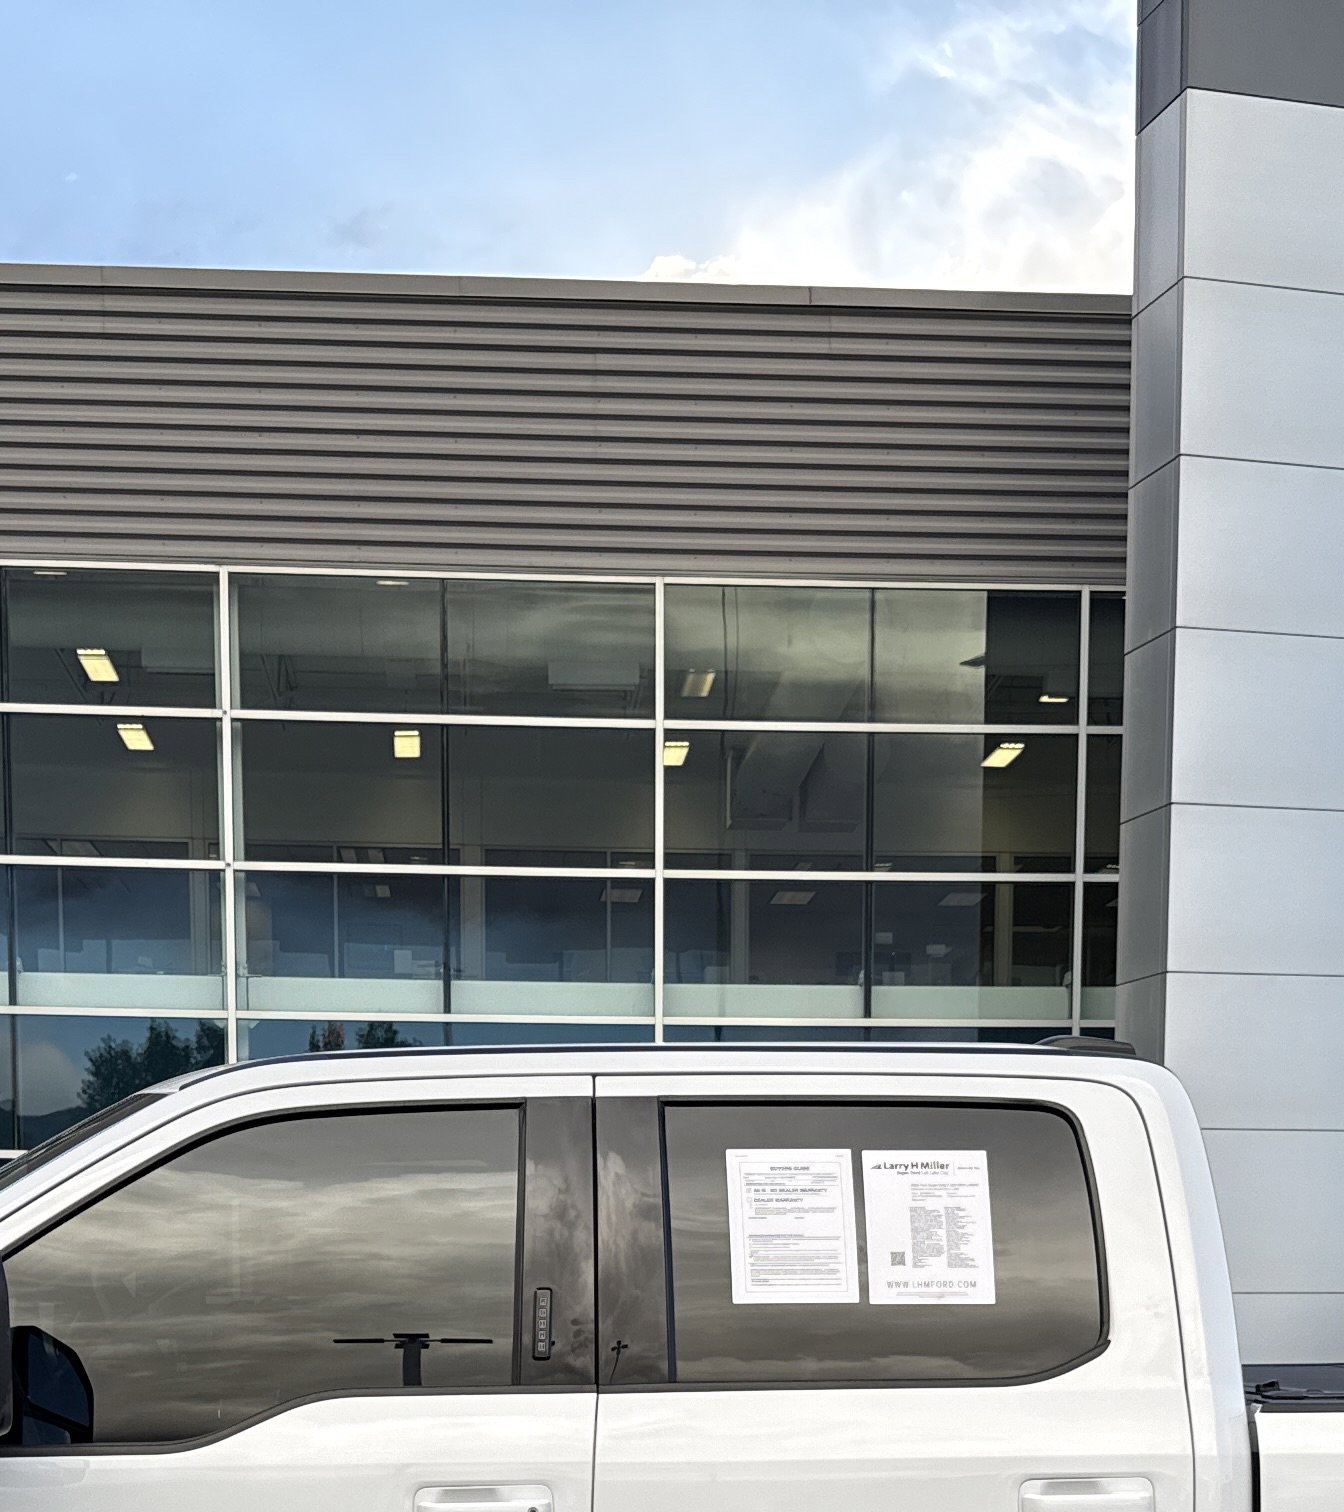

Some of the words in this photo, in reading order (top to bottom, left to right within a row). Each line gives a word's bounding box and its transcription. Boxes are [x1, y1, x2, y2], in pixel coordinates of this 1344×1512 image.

[884, 1162, 909, 1171] Larry
[911, 1162, 918, 1170] H
[920, 1161, 950, 1170] Miller
